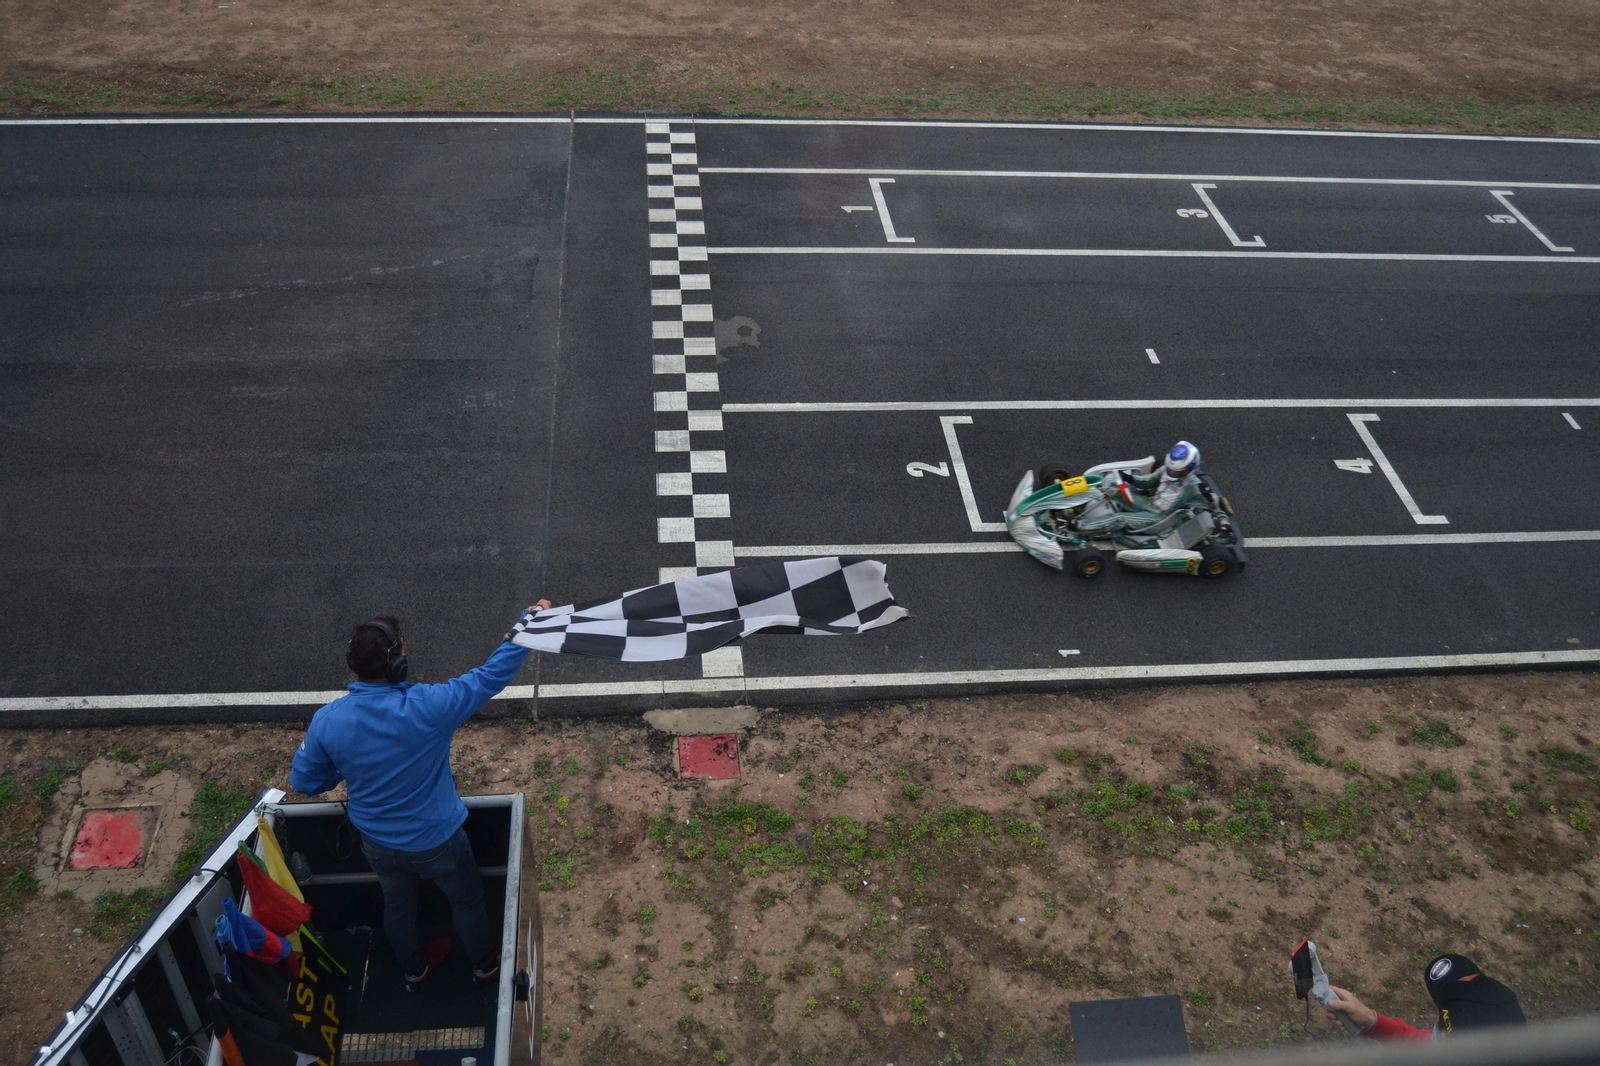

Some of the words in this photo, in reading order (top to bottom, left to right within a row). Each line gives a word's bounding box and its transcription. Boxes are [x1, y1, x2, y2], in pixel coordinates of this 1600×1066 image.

[840, 205, 874, 213] 1
[1176, 208, 1209, 218] 3
[1484, 214, 1517, 224] 5
[906, 461, 950, 477] 2
[1333, 457, 1374, 474] 4
[292, 955, 319, 1030] AST
